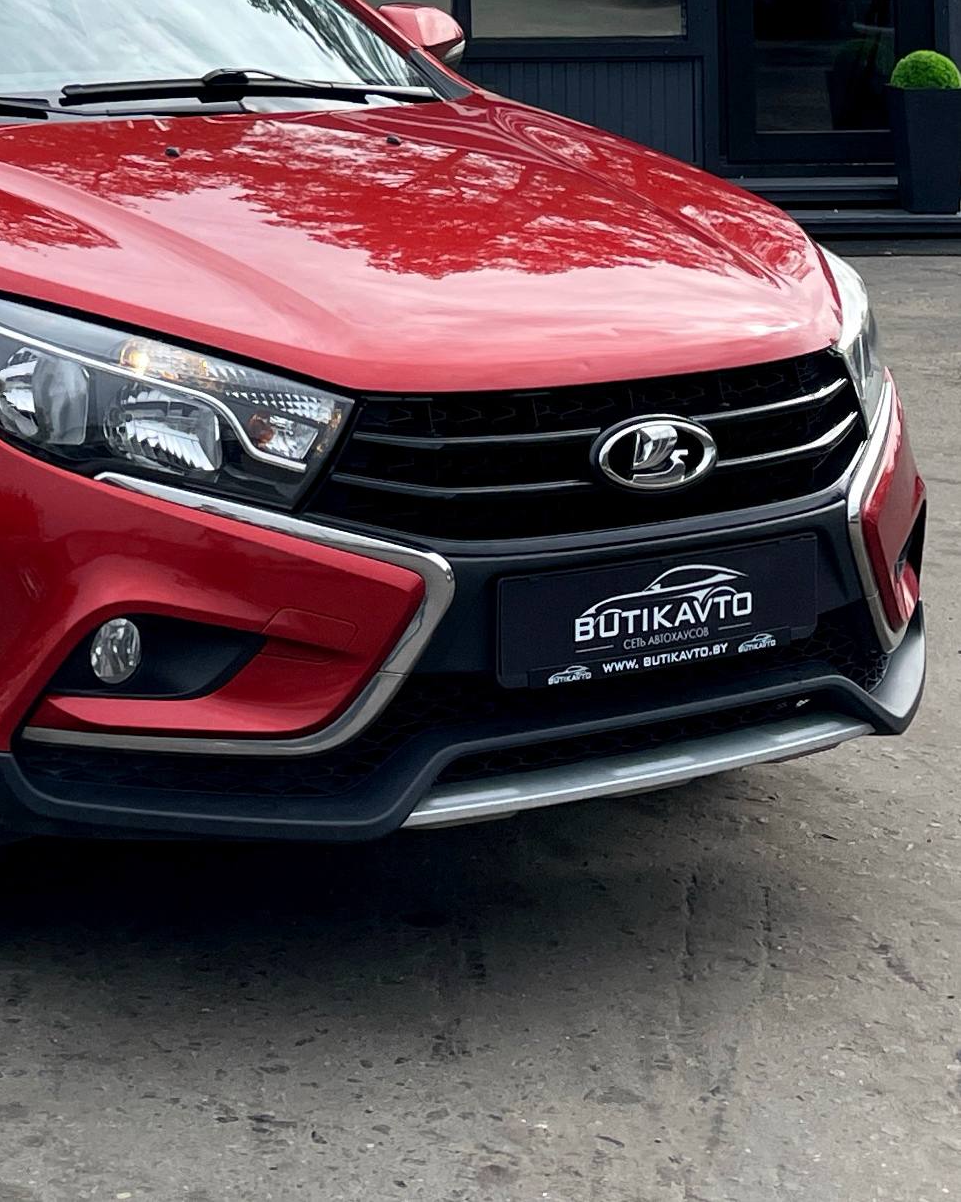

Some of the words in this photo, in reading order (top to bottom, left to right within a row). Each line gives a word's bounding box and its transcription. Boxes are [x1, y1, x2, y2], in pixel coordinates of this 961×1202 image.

[574, 592, 752, 642] BUTIKAVTO
[623, 637, 646, 650] СЕТЬ
[647, 626, 710, 646] АВТОХАУСОВ
